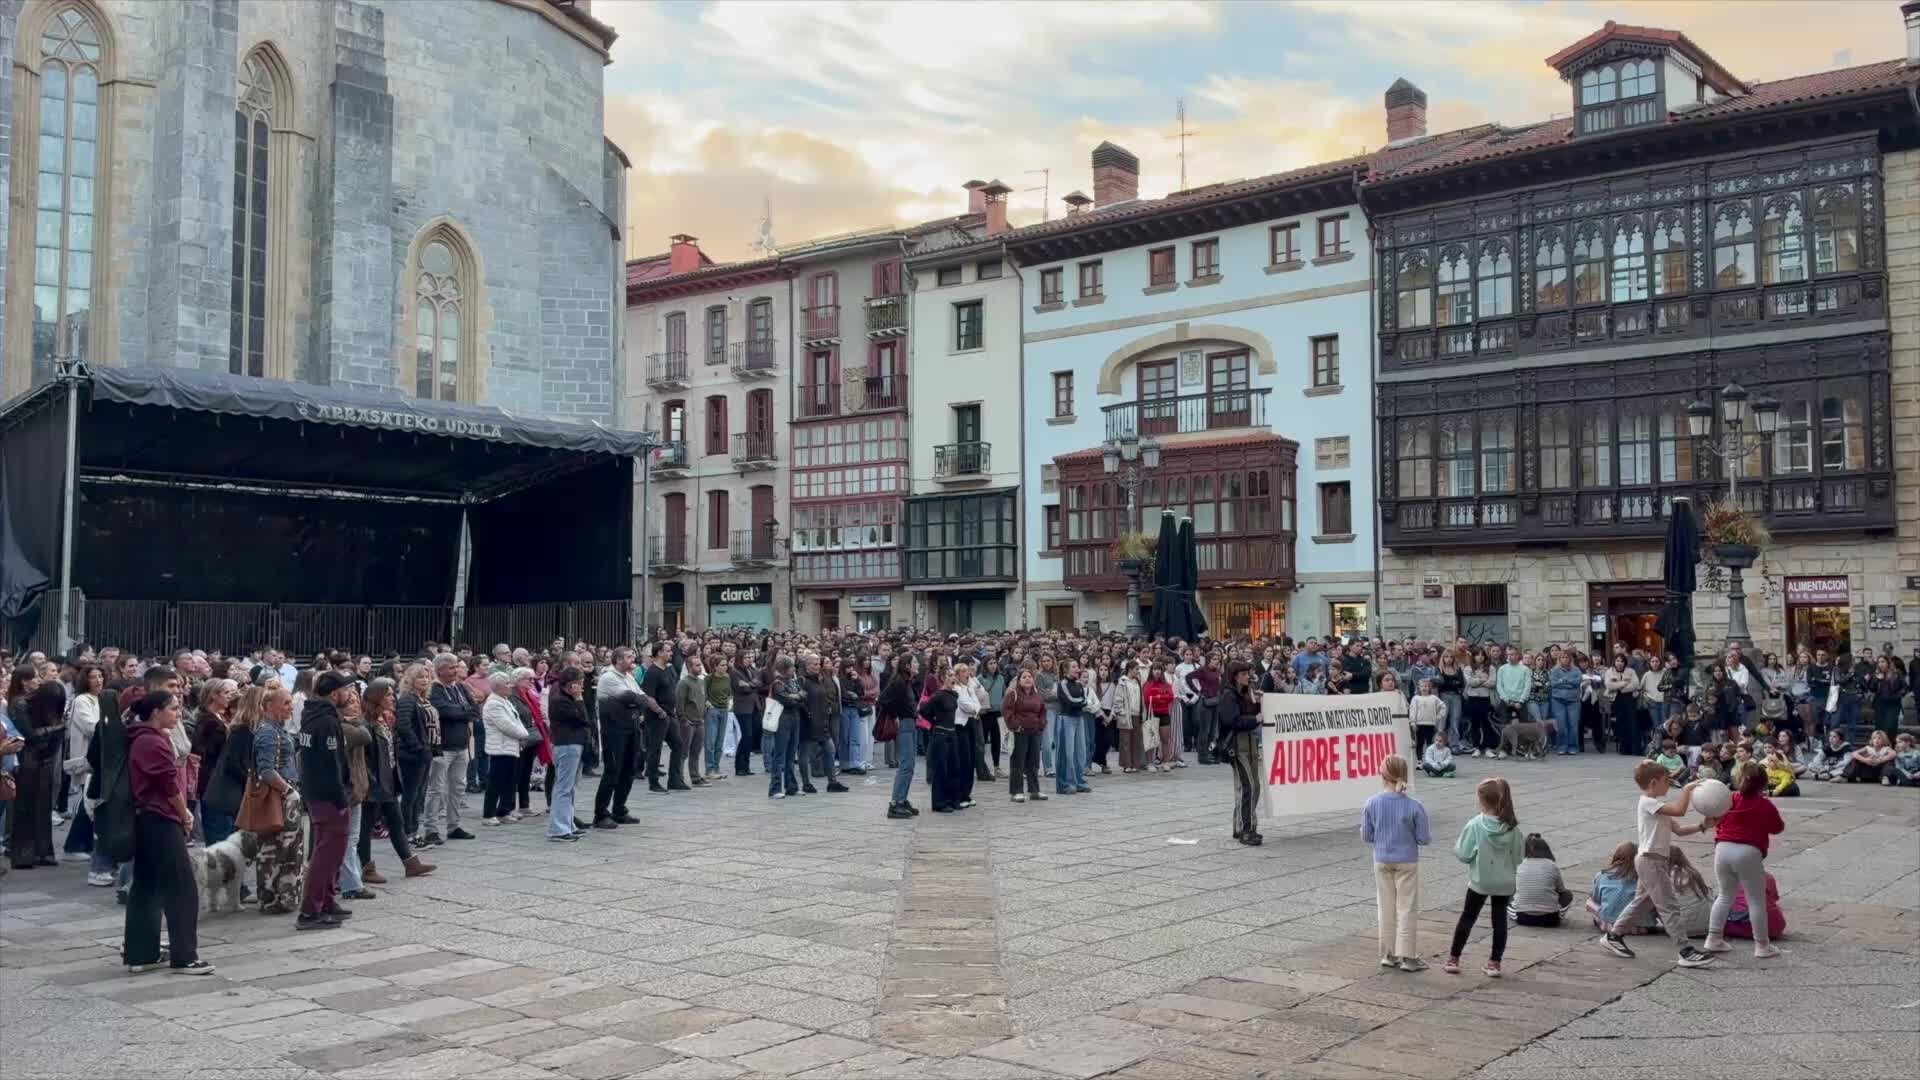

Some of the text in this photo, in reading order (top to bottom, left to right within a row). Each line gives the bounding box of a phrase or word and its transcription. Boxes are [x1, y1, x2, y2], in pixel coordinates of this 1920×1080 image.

[318, 405, 501, 437] ARRASATEKO UDALA
[721, 587, 754, 601] clarel
[1788, 580, 1847, 593] ALIMENTACION
[1274, 706, 1393, 733] INDARKERIA MATXISTA ORORI
[1270, 736, 1341, 785] AURRE
